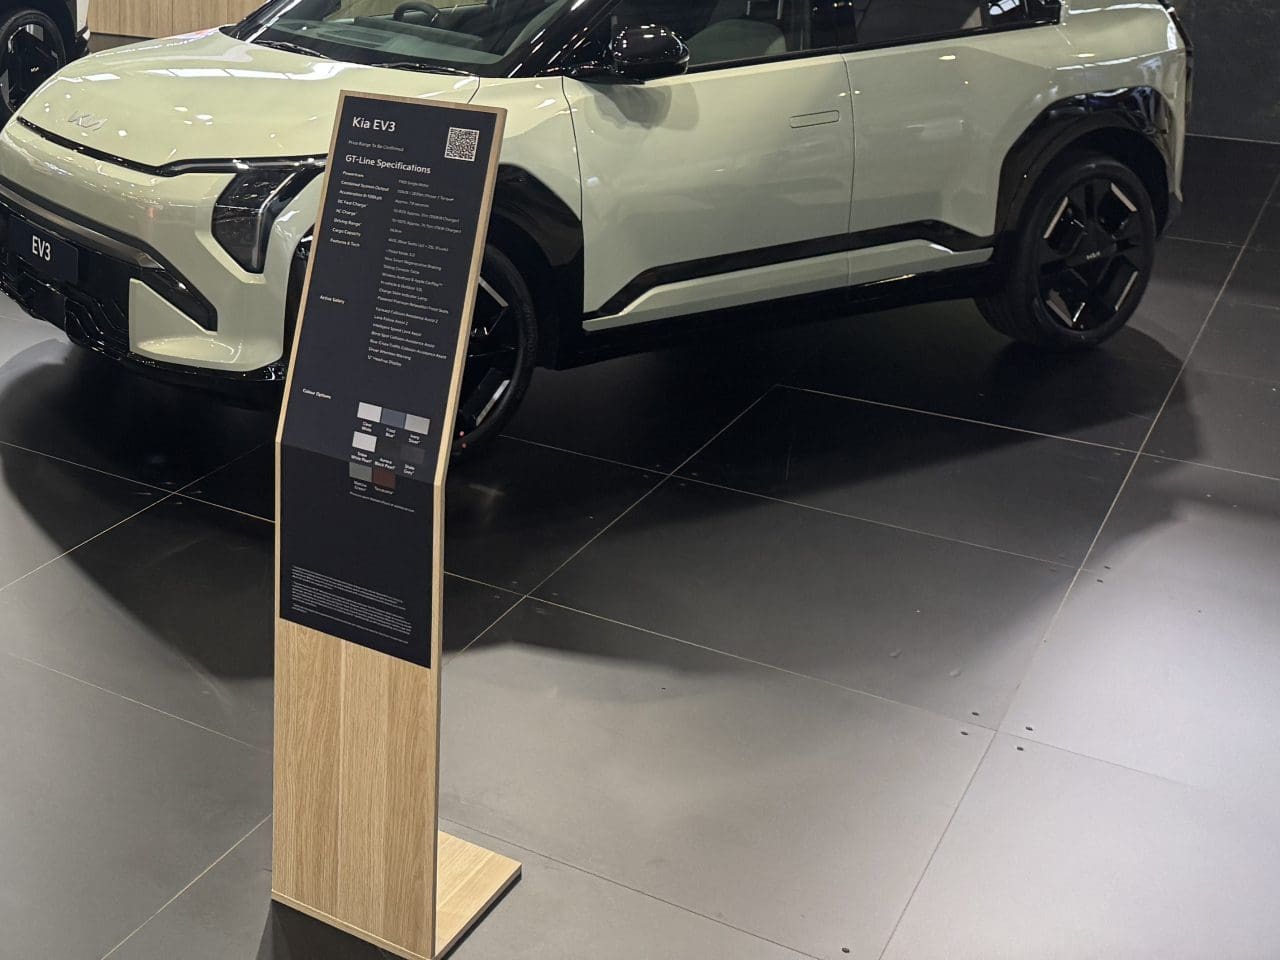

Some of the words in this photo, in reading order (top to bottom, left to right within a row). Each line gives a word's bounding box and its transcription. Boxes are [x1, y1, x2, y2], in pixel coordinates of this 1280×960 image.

[352, 116, 371, 130] Kia
[372, 119, 397, 132] EV3
[345, 154, 376, 167] GT-Line
[376, 159, 432, 175] Specifications
[31, 234, 52, 262] EV3
